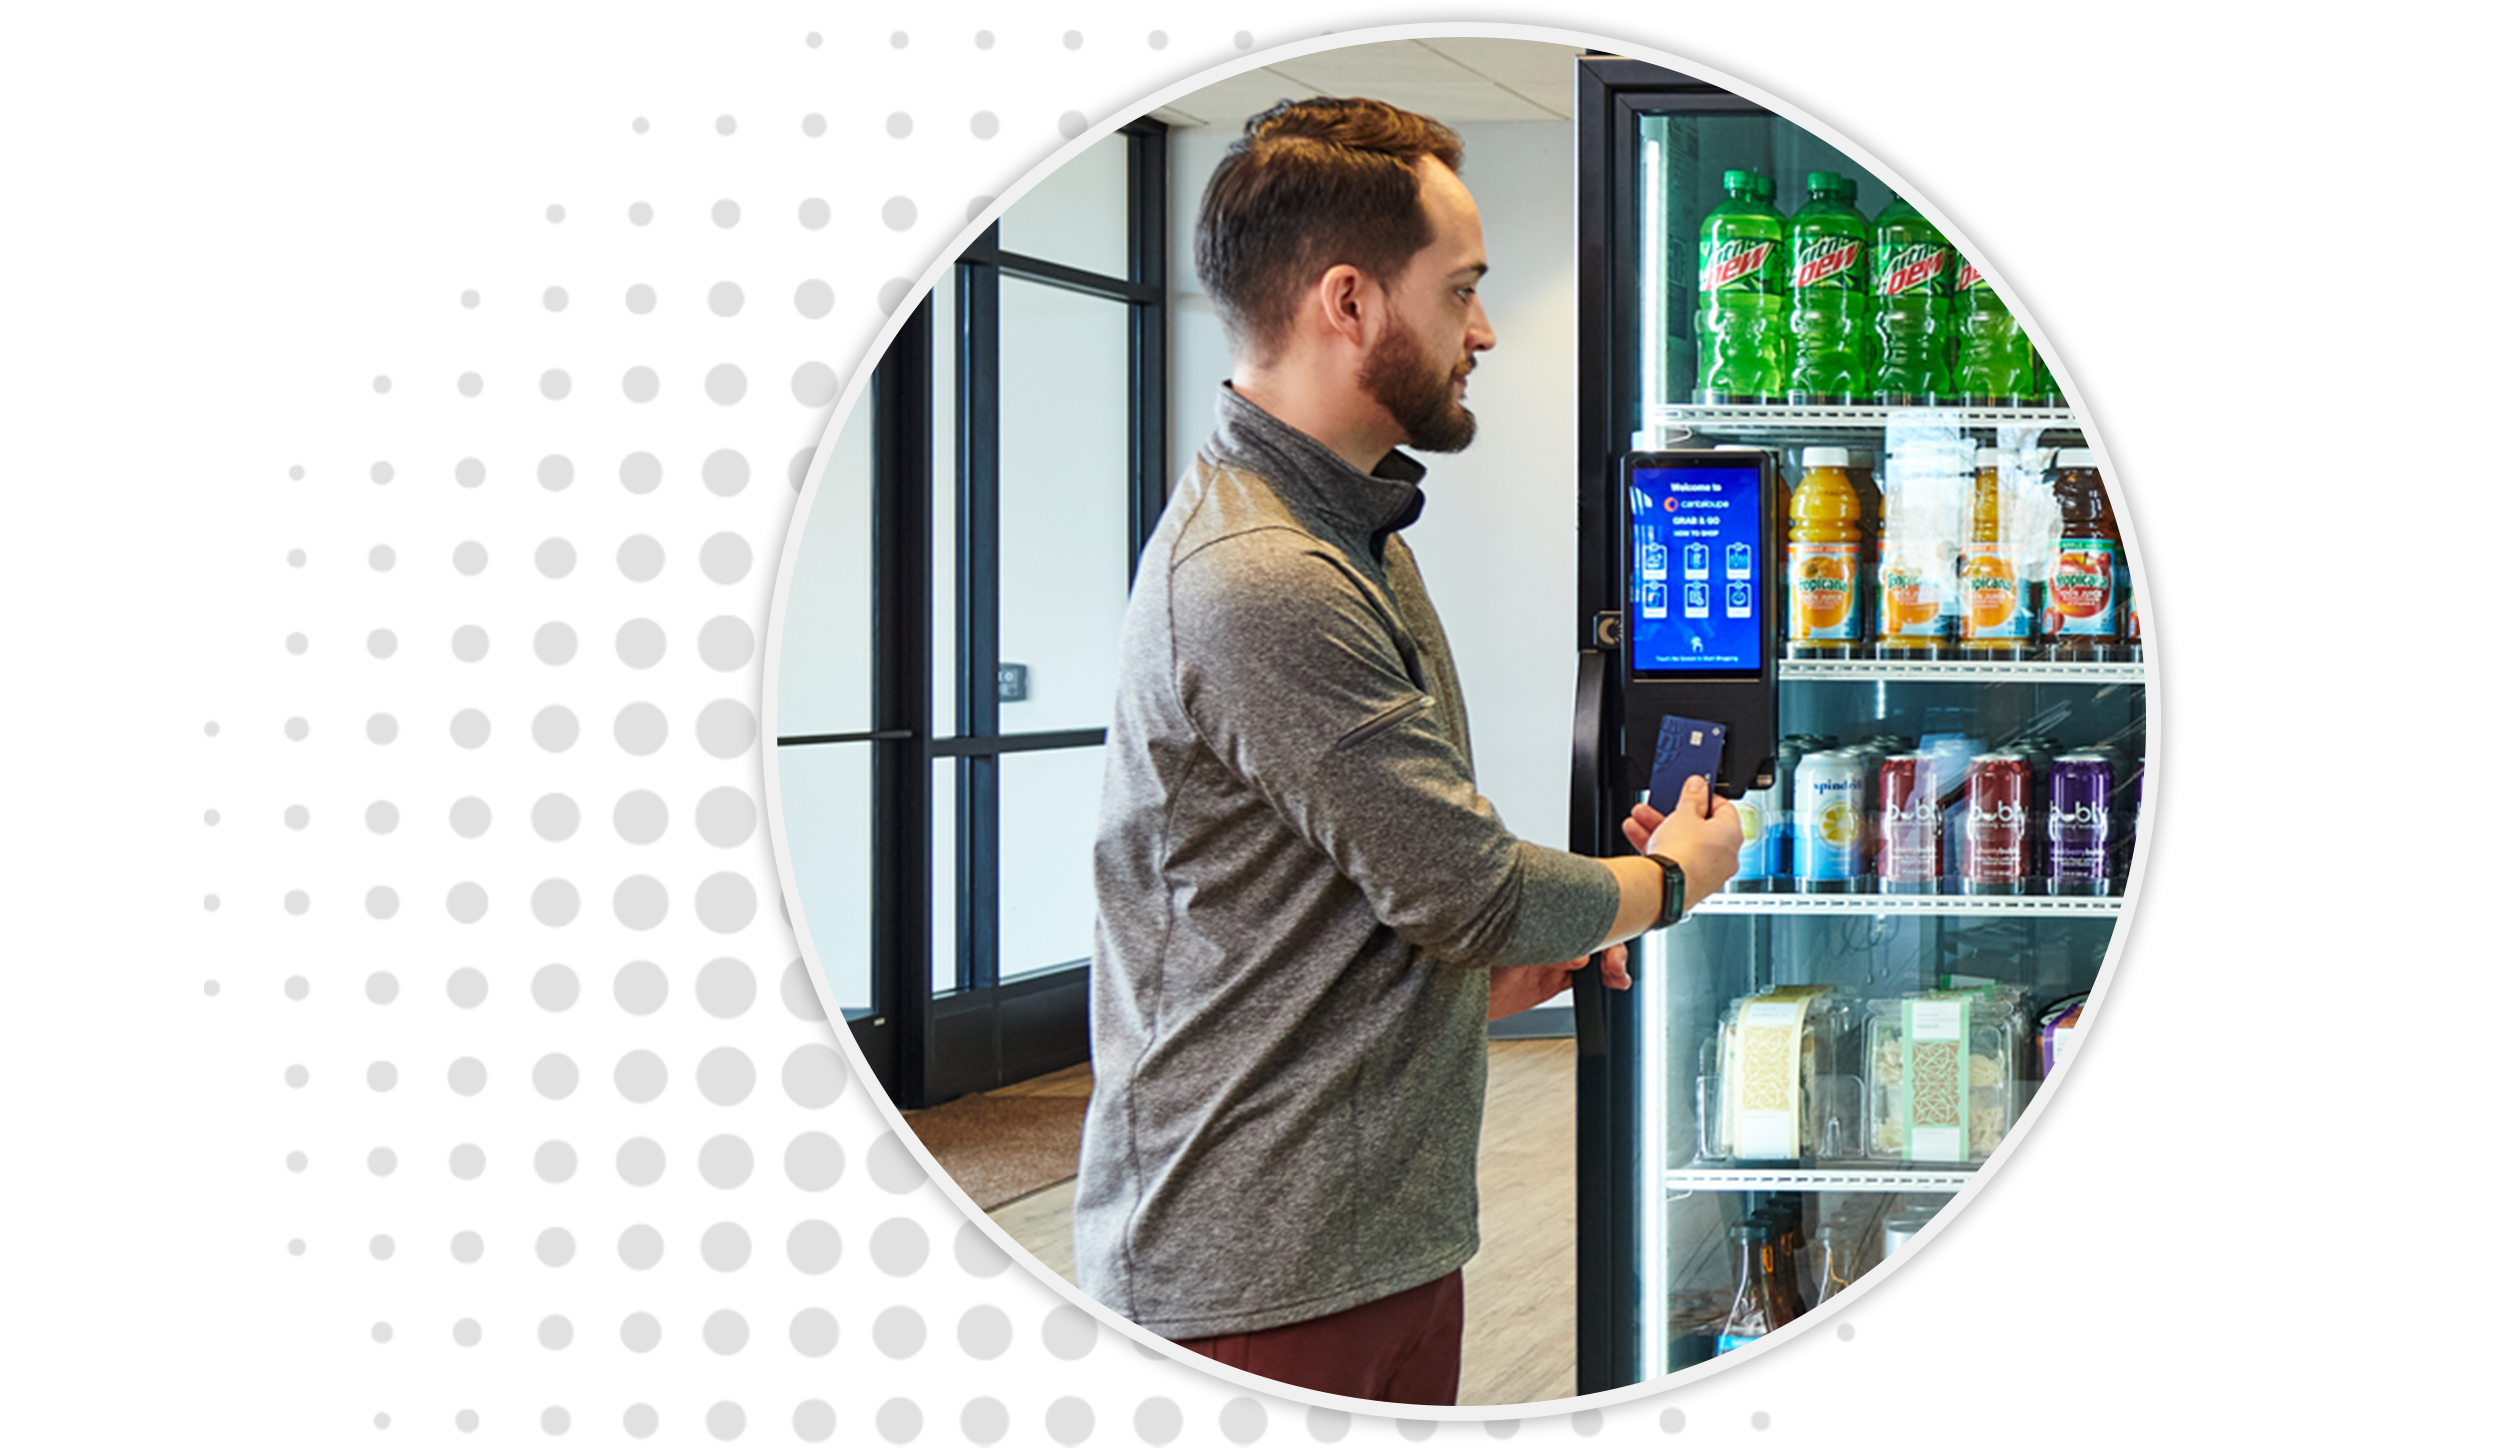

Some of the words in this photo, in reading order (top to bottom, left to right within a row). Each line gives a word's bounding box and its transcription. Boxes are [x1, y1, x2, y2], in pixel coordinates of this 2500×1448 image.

[1670, 482, 1710, 492] Welcome
[1711, 482, 1722, 492] to
[1672, 515, 1698, 526] GRAB
[1706, 515, 1721, 526] GO
